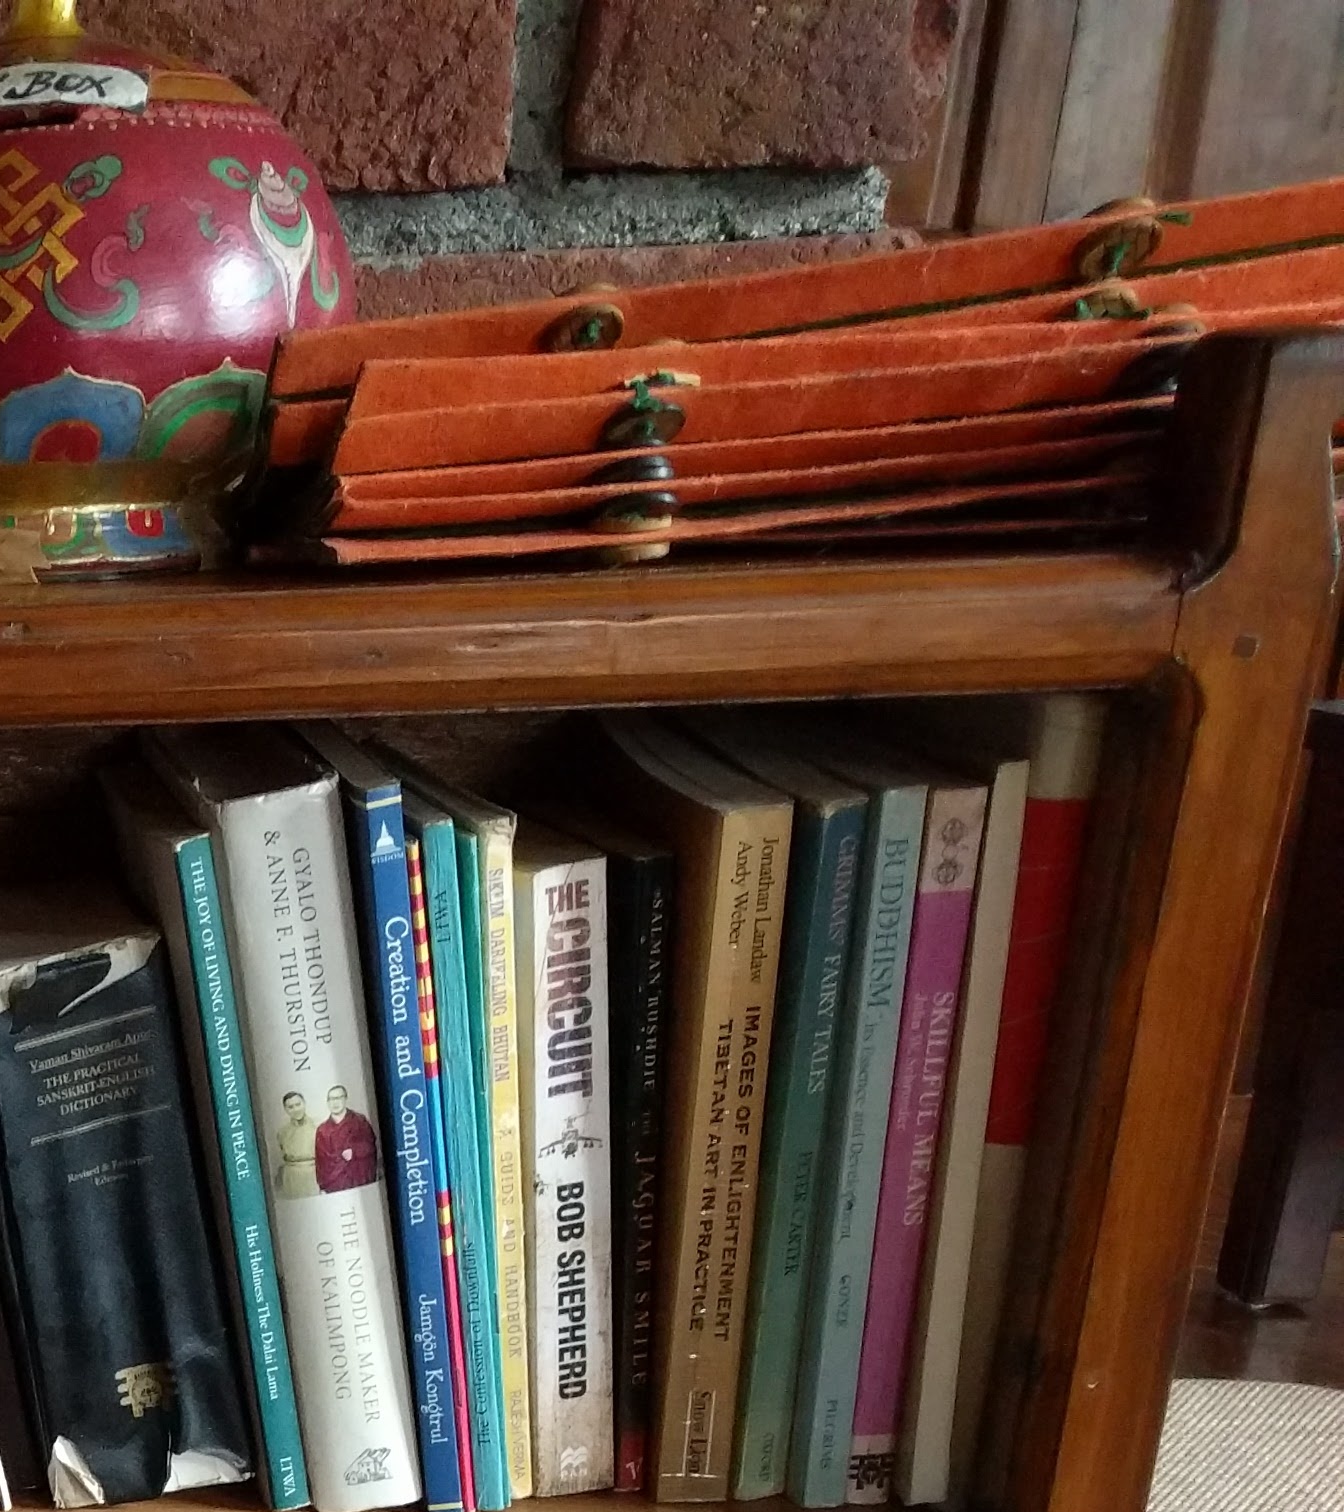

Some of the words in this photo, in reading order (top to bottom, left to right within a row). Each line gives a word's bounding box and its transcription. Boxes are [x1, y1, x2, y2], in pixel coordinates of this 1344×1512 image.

[3, 72, 113, 99] BOX
[290, 847, 319, 928] GYALO
[545, 879, 590, 913] THE
[303, 933, 334, 1045] THONDUP
[384, 915, 409, 1026] Creation
[545, 917, 595, 1099] CIRCUIT
[395, 1034, 414, 1079] and
[736, 1005, 761, 1104] IMAGES
[398, 1086, 427, 1227] Completion
[736, 1106, 753, 1136] OF
[555, 1181, 585, 1240] BOB
[714, 1140, 750, 1343] ENLIGHTENMENT
[554, 1244, 589, 1400] SHEPHERD
